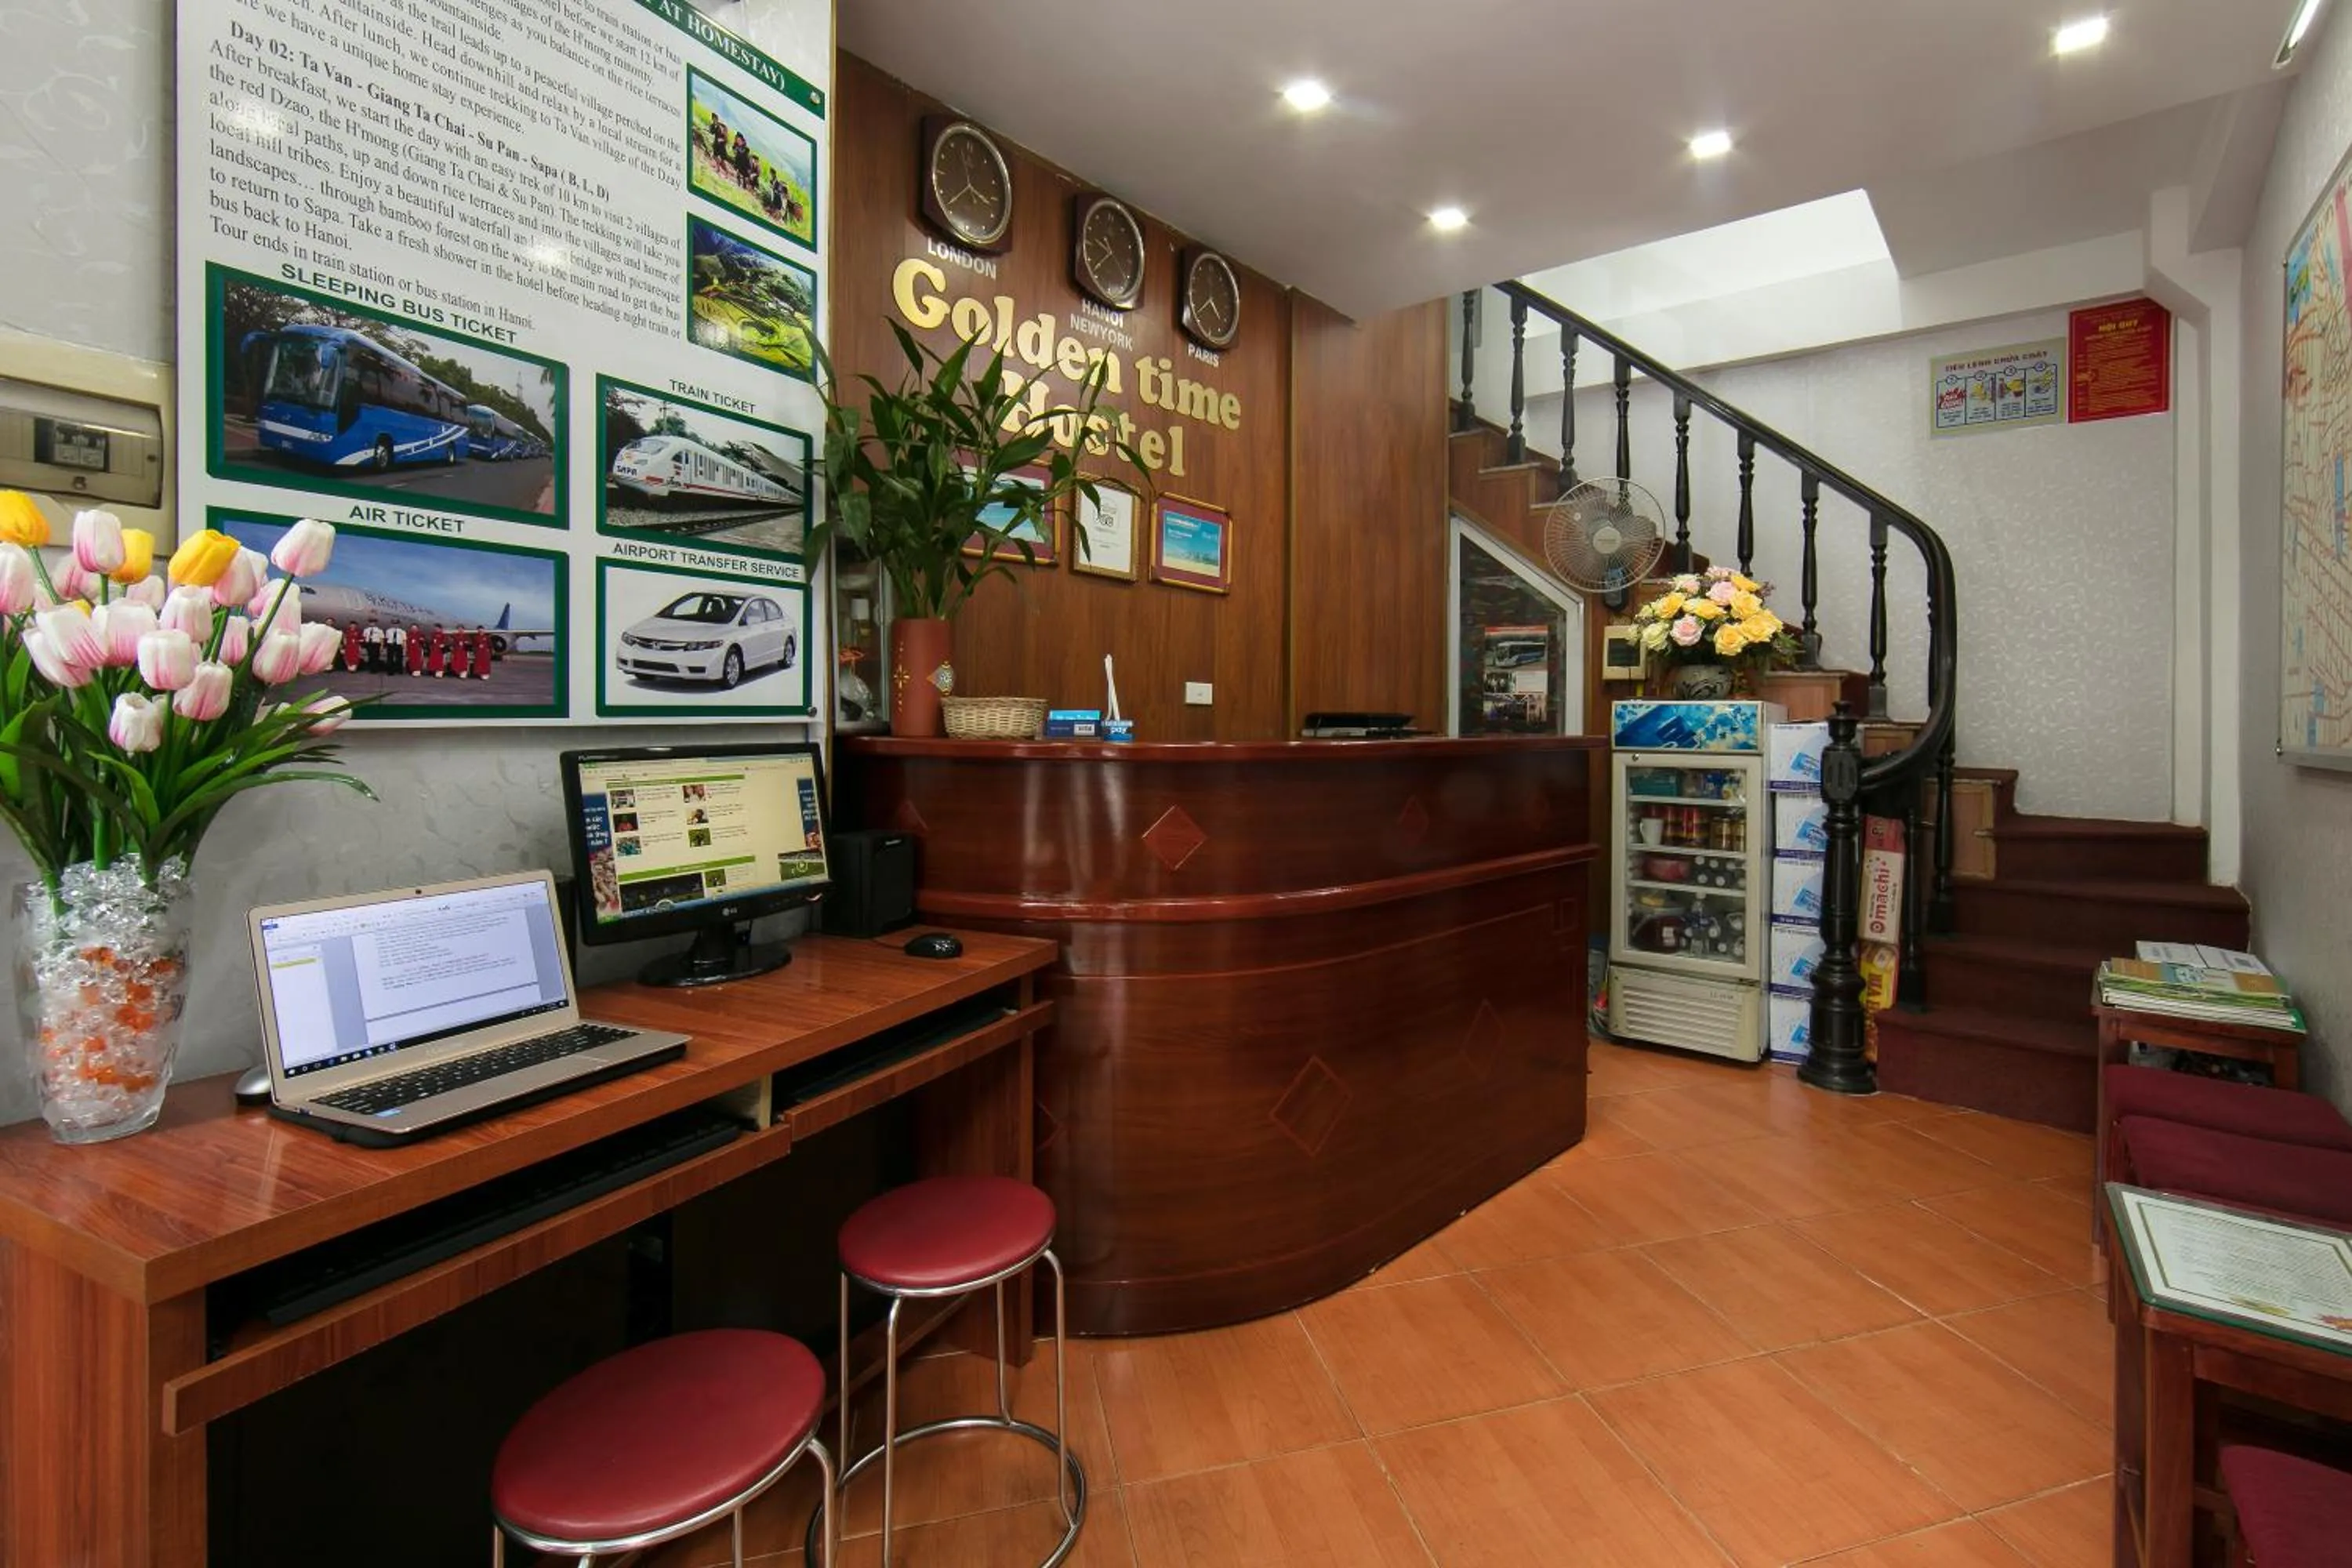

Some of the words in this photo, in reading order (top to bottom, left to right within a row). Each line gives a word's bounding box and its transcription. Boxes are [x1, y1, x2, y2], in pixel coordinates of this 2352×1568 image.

[320, 1, 358, 34] After
[362, 21, 405, 59] lunch,
[409, 49, 428, 68] we
[432, 60, 485, 96] continue
[489, 85, 536, 124] trekking
[539, 110, 550, 127] to
[408, 1, 426, 24] the
[431, 13, 456, 39] trail
[459, 27, 489, 56] leads
[492, 48, 507, 69] up
[510, 54, 521, 73] to
[524, 64, 531, 78] a
[534, 69, 577, 101] peaceful
[510, 17, 523, 34] as
[526, 26, 546, 46] you
[540, 13, 551, 29] of
[659, 0, 683, 21] AT
[688, 10, 786, 91] HOMESTAY)
[230, 18, 261, 53] Day
[269, 35, 293, 63] 02:
[302, 51, 318, 74] Ta
[324, 60, 352, 89] Van
[367, 80, 409, 118] Giang
[416, 102, 430, 123] Ta
[434, 111, 464, 138] Chai
[477, 129, 493, 151] Su
[497, 139, 519, 162] Pan
[531, 154, 557, 180] Sapa
[263, 3, 286, 25] we
[290, 11, 325, 43] have
[329, 34, 338, 49] a
[342, 39, 389, 72] unique
[392, 58, 428, 90] home
[432, 82, 456, 107] stay
[460, 95, 525, 136] experience.
[422, 29, 456, 60] Head
[460, 48, 514, 89] downhill
[518, 82, 539, 101] and
[541, 93, 568, 116] relax
[209, 63, 234, 88] the
[240, 78, 264, 100] red
[270, 85, 314, 122] Dzao,
[318, 107, 340, 130] the
[345, 117, 398, 158] H'mong
[401, 140, 445, 177] (Giang
[452, 161, 463, 180] Ta
[467, 168, 494, 193] Chai
[497, 180, 508, 199] &
[511, 187, 526, 206] Su
[211, 35, 252, 70] After
[257, 56, 331, 105] breakfast,
[336, 94, 356, 114] we
[360, 104, 390, 129] start
[394, 116, 413, 138] the
[417, 125, 440, 153] day
[445, 141, 470, 162] with
[474, 154, 488, 169] an
[490, 161, 516, 185] easy
[519, 171, 539, 191] trek
[542, 183, 555, 198] of
[209, 188, 238, 214] bus
[243, 199, 279, 227] back
[285, 215, 299, 234] to
[304, 220, 351, 251] Hanoi.
[304, 129, 347, 158] paths,
[352, 147, 370, 169] up
[374, 156, 398, 176] and
[402, 163, 438, 192] down
[442, 181, 466, 203] rice
[469, 191, 514, 222] terraces
[517, 213, 538, 231] and
[339, 161, 380, 196] Enjoy
[384, 183, 393, 197] a
[397, 183, 454, 220] beautiful
[459, 211, 510, 241] waterfall
[209, 165, 226, 185] to
[230, 175, 279, 203] return
[284, 191, 299, 210] to
[303, 195, 343, 225] Sapa.
[351, 212, 381, 238] Take
[384, 228, 393, 242] a
[397, 228, 429, 254] fresh
[434, 243, 476, 270] shower
[480, 257, 492, 275] in
[495, 264, 513, 283] the
[516, 270, 543, 293] hotel
[211, 214, 246, 242] Tour
[252, 232, 288, 255] ends
[293, 240, 307, 261] in
[312, 248, 344, 272] train
[349, 262, 394, 287] station
[398, 278, 411, 292] or
[415, 279, 437, 300] bus
[441, 290, 481, 314] station
[484, 300, 495, 318] in
[320, 180, 374, 214] through
[379, 199, 431, 234] bamboo
[436, 220, 470, 247] forest
[472, 238, 488, 254] on
[491, 241, 508, 261] the
[512, 252, 534, 274] way
[927, 237, 996, 280] LONDON
[281, 263, 395, 308] SLEEPING
[402, 299, 445, 322] BUS
[451, 313, 517, 343] TICKET
[892, 258, 1123, 394] Golden
[1134, 355, 1243, 431] time
[1070, 314, 1133, 352] NEWYORK
[1082, 299, 1123, 328] HANOI
[670, 379, 709, 400] TRAIN
[713, 392, 756, 413] TICKET
[1188, 343, 1220, 368] PARIS
[1000, 369, 1185, 477] Hostel
[350, 505, 386, 523] AIR
[393, 511, 465, 532] TICKET
[614, 543, 677, 561] AIRPORT
[681, 552, 746, 572] TRANSFER
[750, 562, 799, 578] SERVICE
[1869, 868, 1890, 934] Omachi
